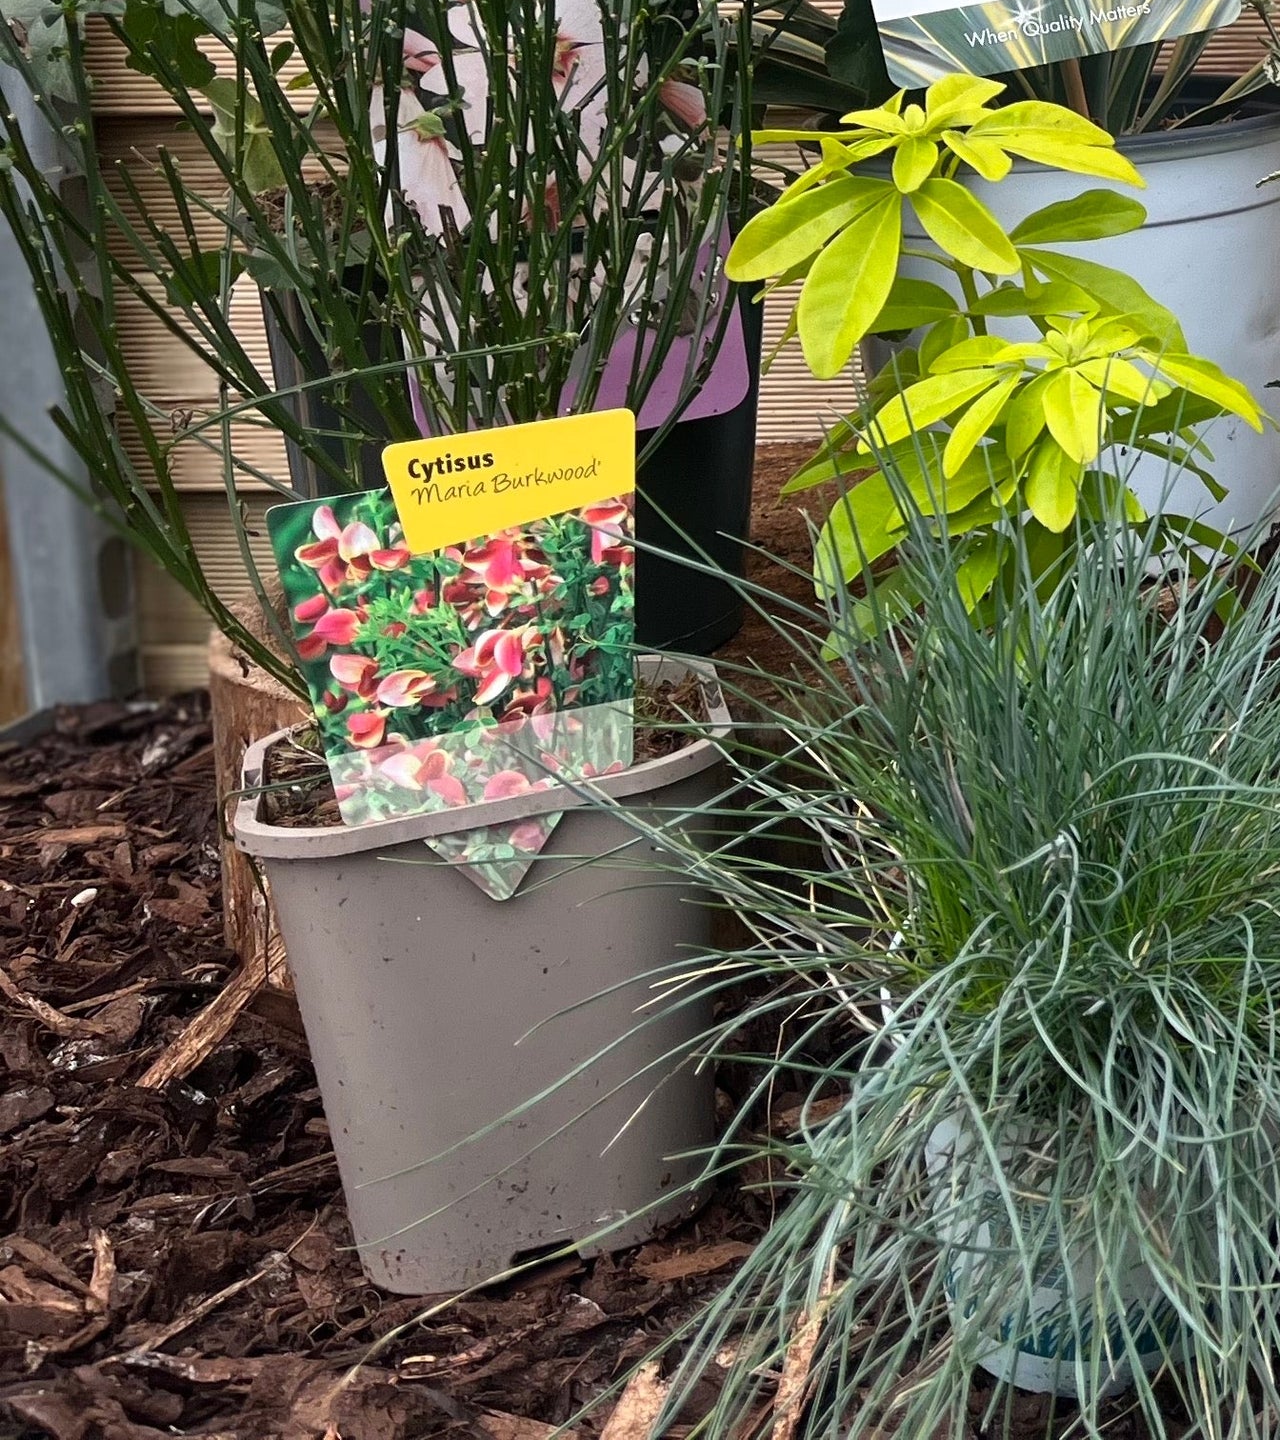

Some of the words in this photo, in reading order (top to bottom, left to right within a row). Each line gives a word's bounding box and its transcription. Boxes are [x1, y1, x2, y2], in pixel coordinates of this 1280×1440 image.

[964, 25, 1018, 48] When
[1022, 11, 1083, 38] Quality
[1089, 2, 1151, 26] Matters
[407, 452, 494, 483] Cytisus
[491, 456, 601, 494] Burkwood'
